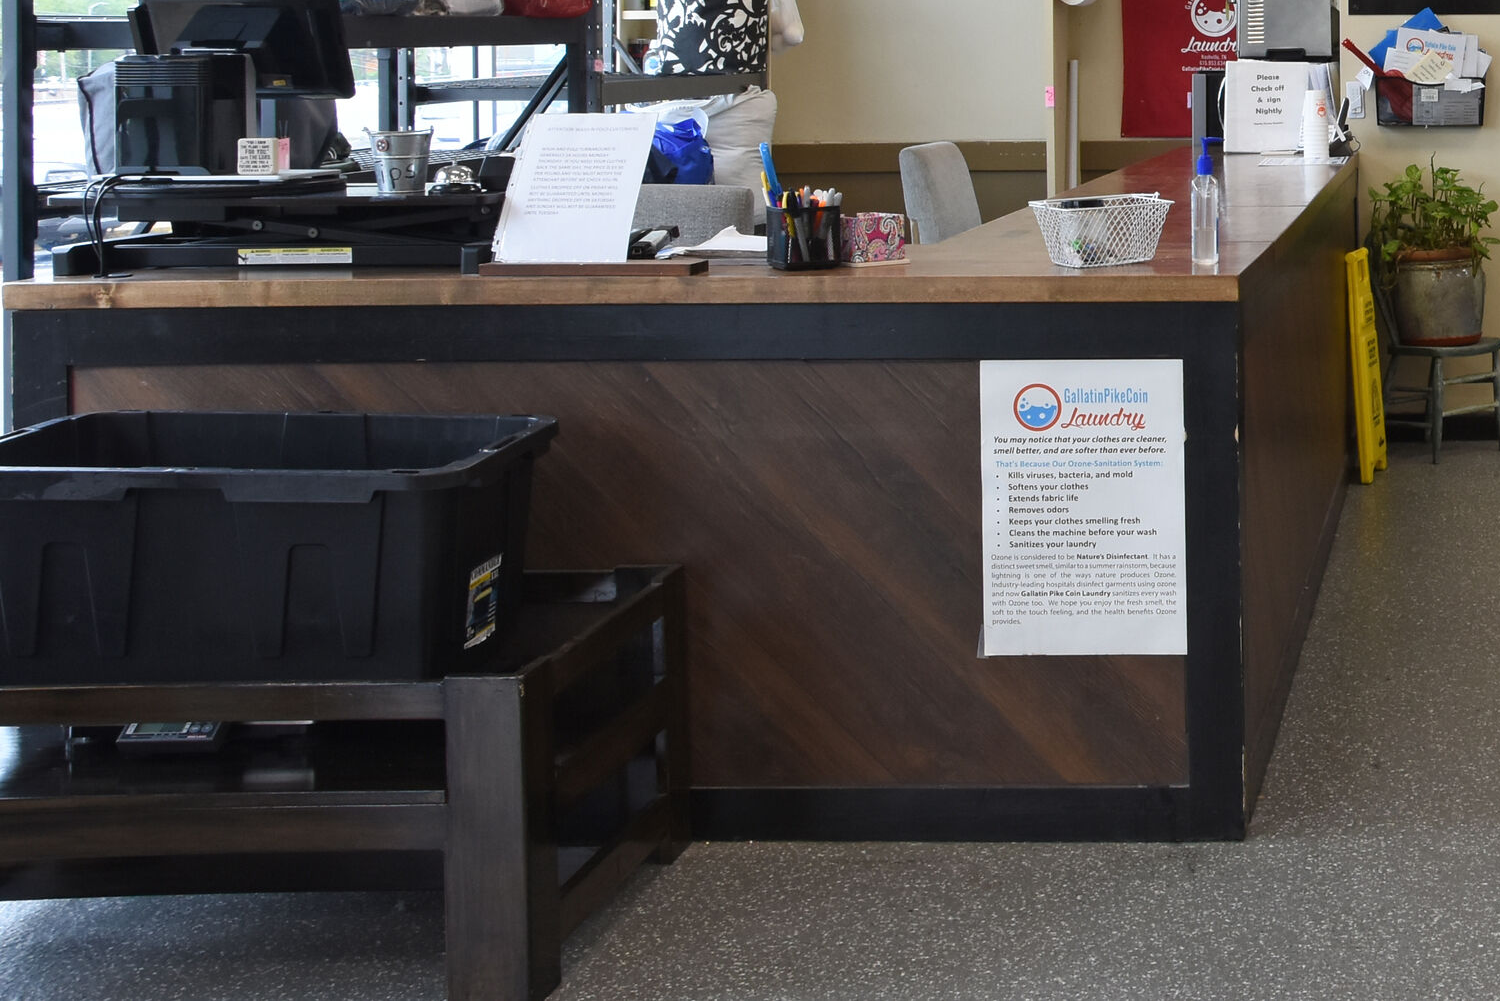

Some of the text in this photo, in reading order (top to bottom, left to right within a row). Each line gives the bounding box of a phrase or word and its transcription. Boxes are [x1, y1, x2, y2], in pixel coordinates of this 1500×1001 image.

[1256, 107, 1282, 115] Nightly
[1063, 388, 1148, 404] GallatinPikeCoin
[1061, 406, 1145, 431] Laundry
[1135, 435, 1167, 443] cleaner,
[1059, 471, 1093, 479] bacteria,
[1009, 518, 1032, 526] Keeps
[1086, 517, 1118, 525] smelling
